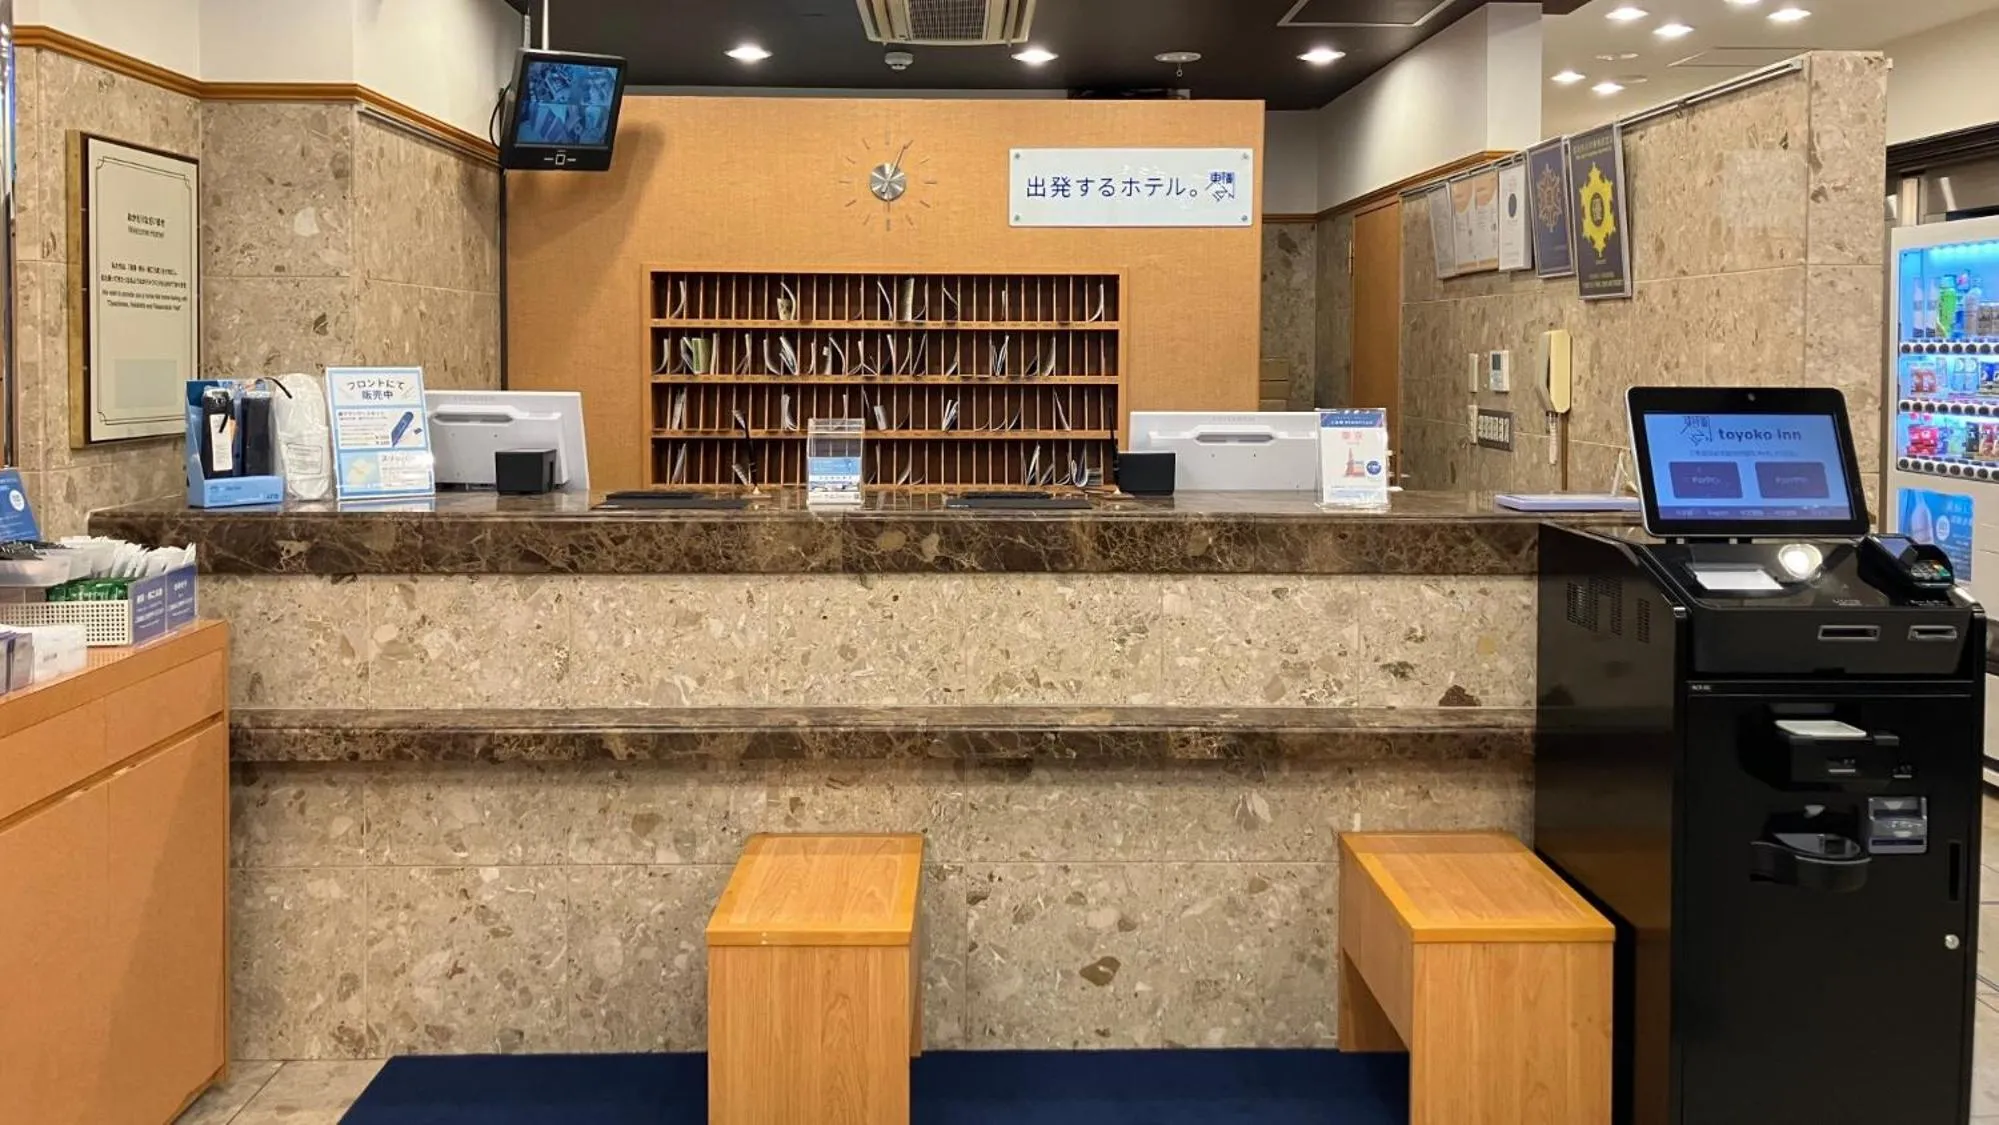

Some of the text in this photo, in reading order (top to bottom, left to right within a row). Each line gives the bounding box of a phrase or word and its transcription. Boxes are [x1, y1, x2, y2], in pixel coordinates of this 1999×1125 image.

[1026, 175, 1198, 198] 出発するホテル。
[347, 378, 404, 390] フロントにて
[361, 390, 393, 400] 販売中
[1718, 428, 1802, 442] toyoko inn
